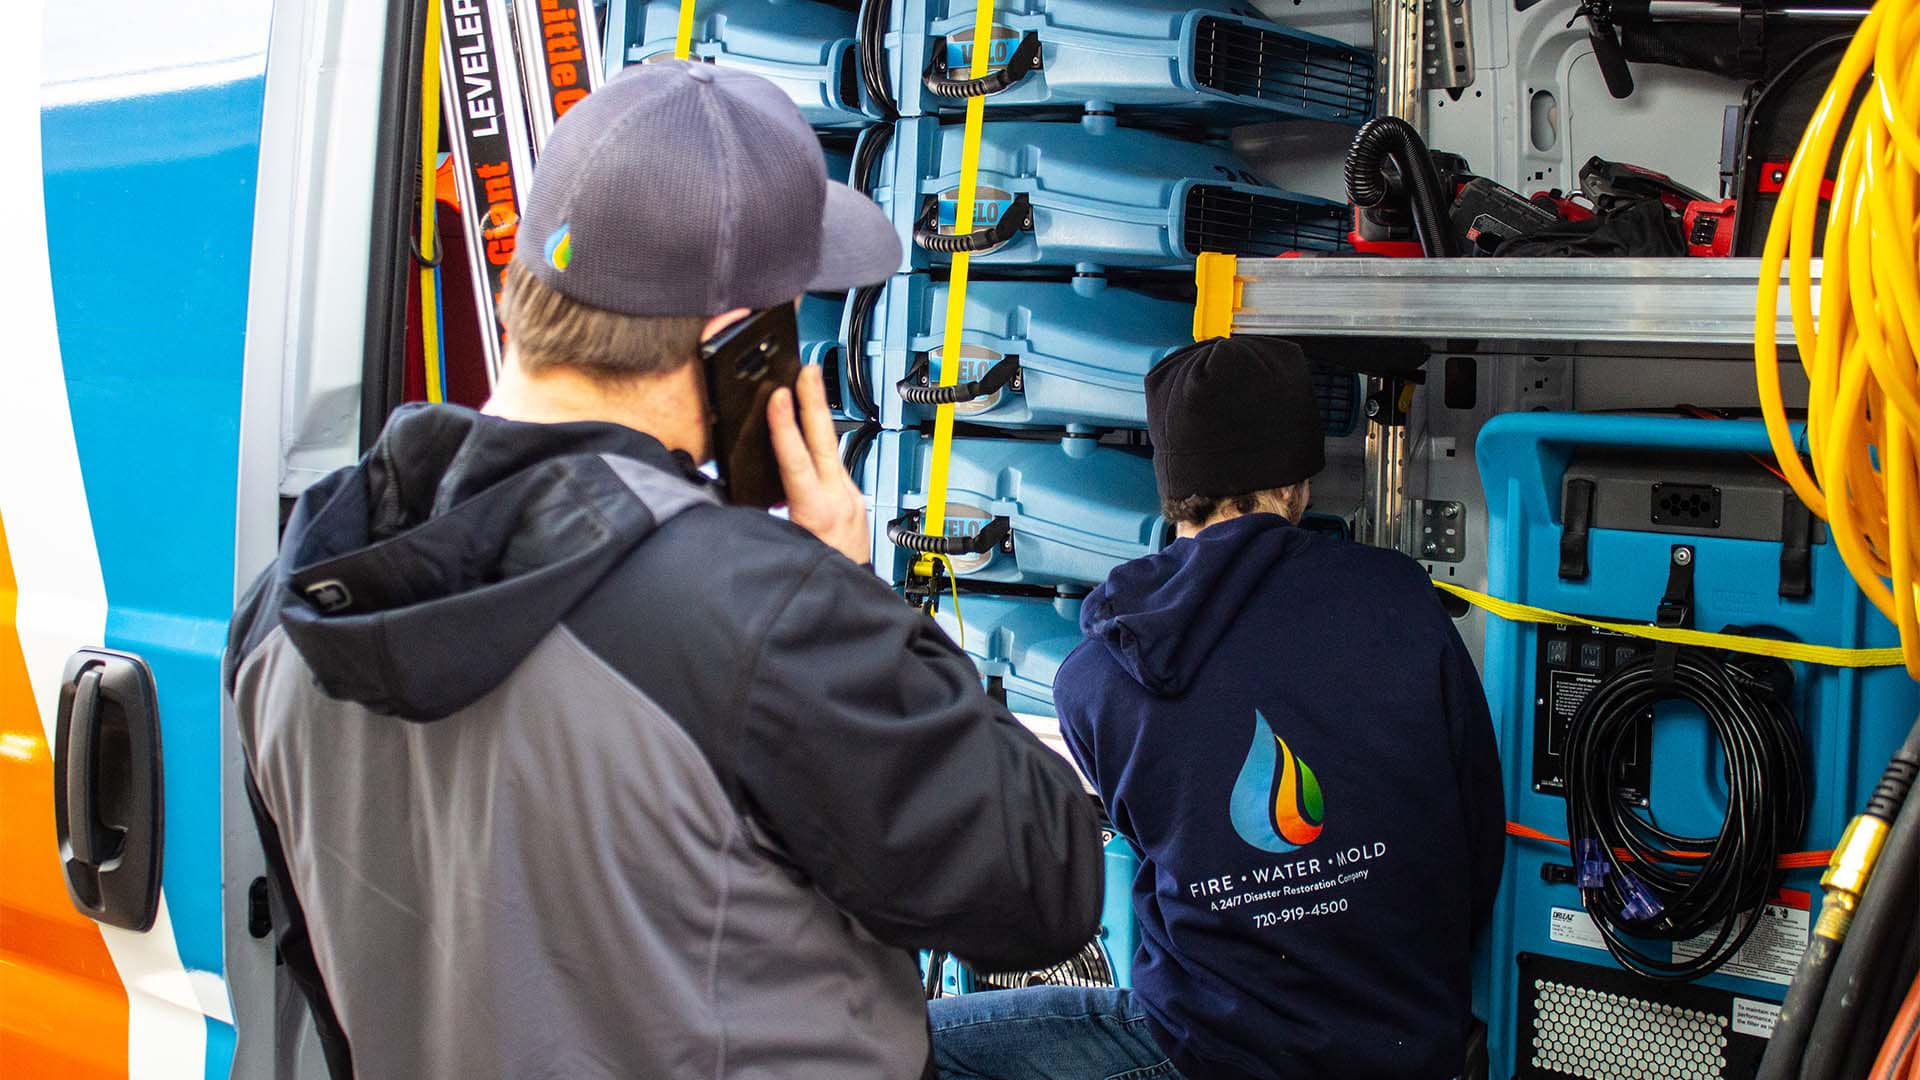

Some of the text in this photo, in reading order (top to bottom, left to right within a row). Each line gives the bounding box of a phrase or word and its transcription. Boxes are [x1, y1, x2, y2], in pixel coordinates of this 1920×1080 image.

[475, 161, 519, 265] Giant
[958, 361, 989, 380] ELO
[947, 520, 979, 537] ELO
[1190, 842, 1386, 898] FIRE WATER MOLD
[1211, 869, 1369, 911] A 24/7 Disaster Restoration Company
[1253, 898, 1348, 929] 720-919-4500
